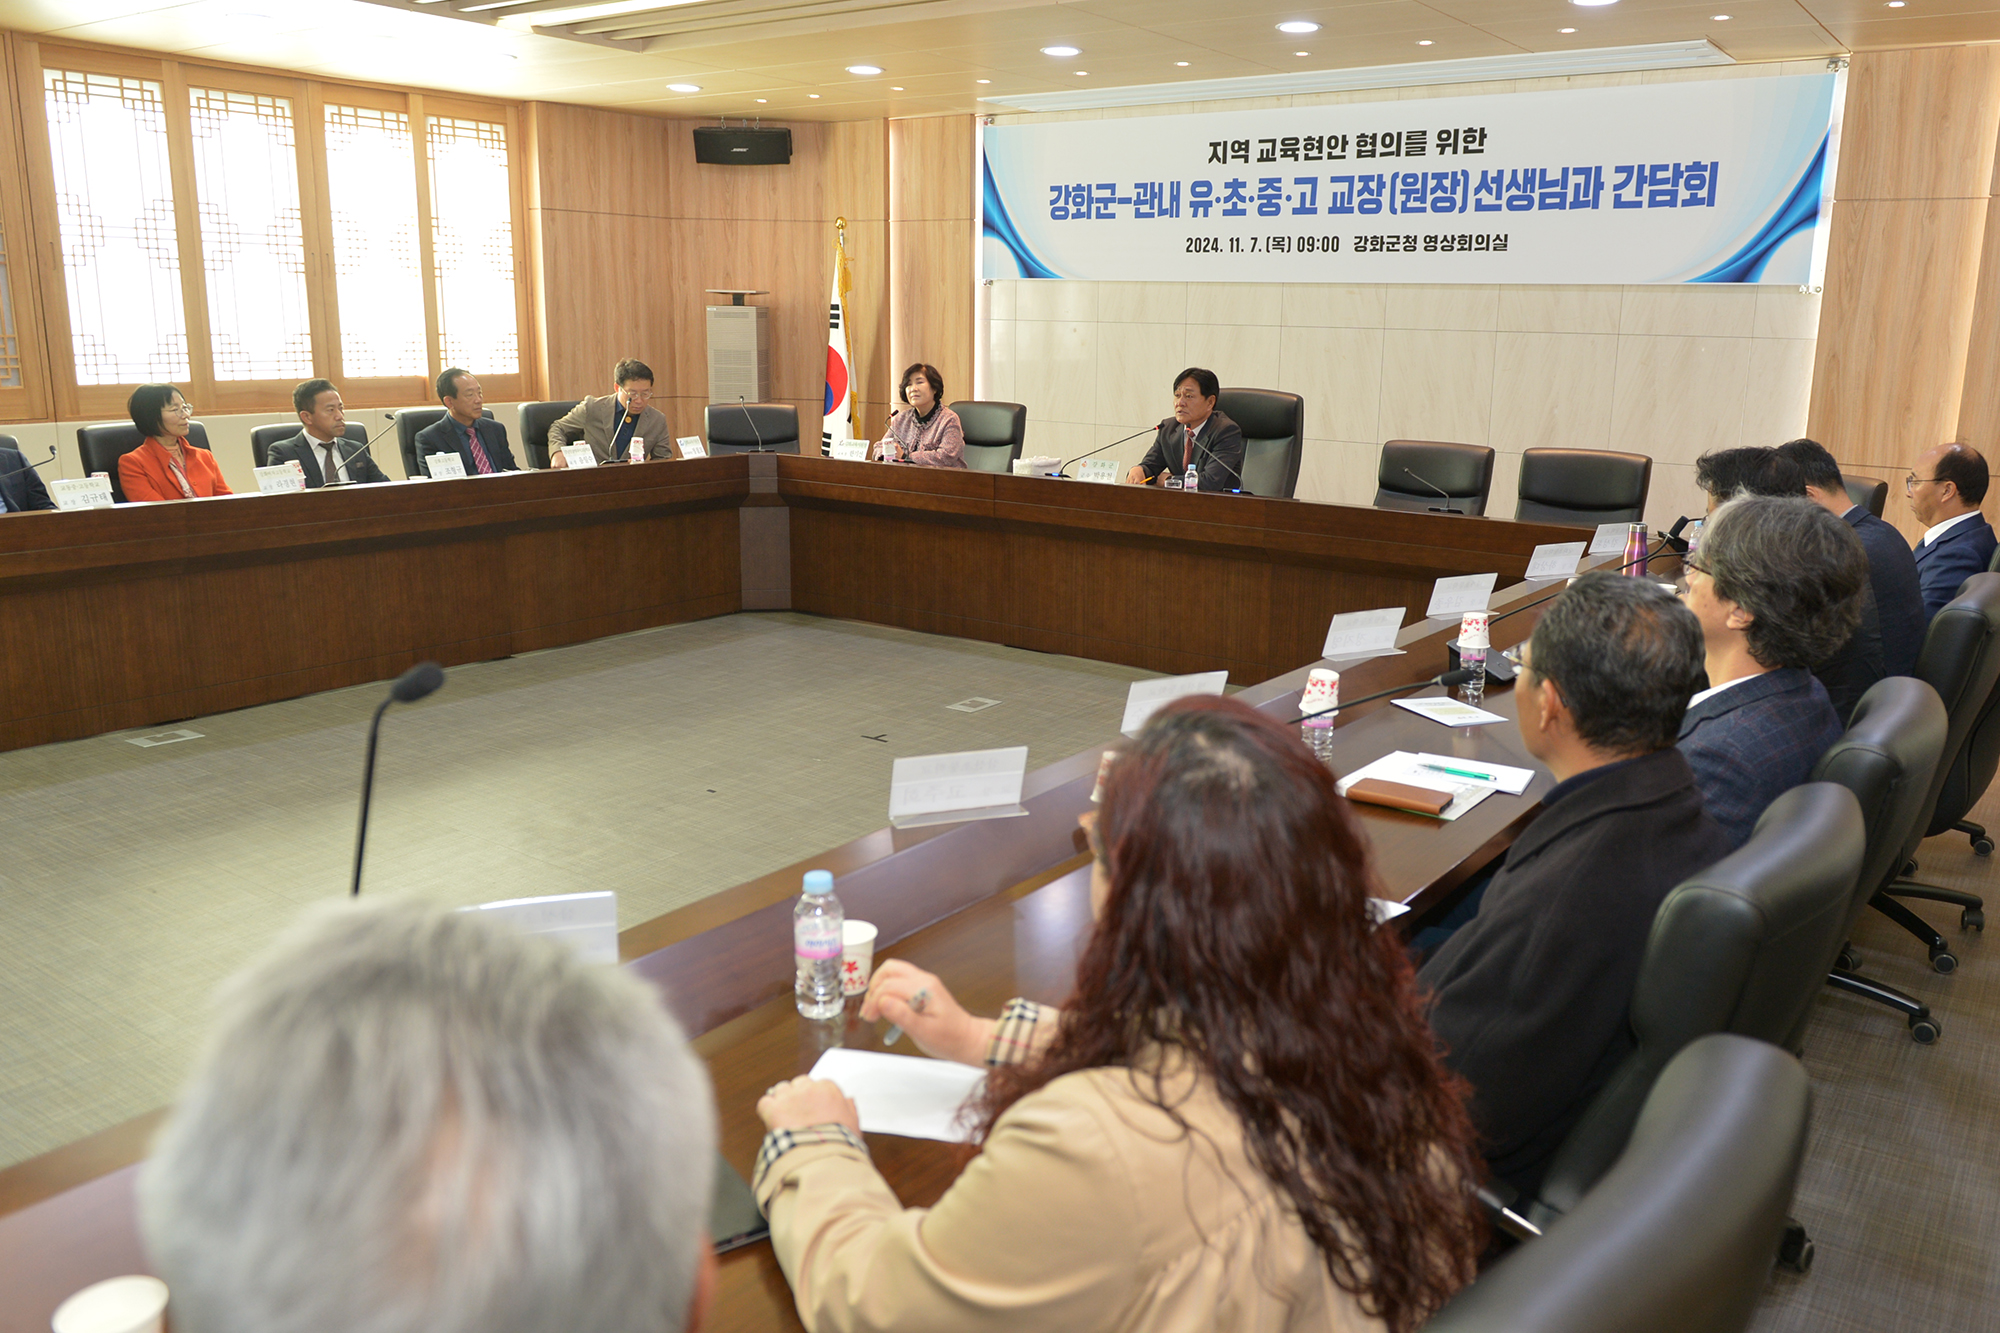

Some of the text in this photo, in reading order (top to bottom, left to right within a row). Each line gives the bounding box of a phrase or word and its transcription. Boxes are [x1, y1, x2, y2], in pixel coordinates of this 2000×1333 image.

[1209, 126, 1488, 165] 지역 교육현안 협의를 위한
[1050, 182, 1181, 220] 강화군-관내
[1613, 161, 1719, 209] 간담회
[1186, 236, 1224, 254] 2024.
[1229, 236, 1245, 253] 11.
[1297, 235, 1340, 253] 09:00
[1354, 234, 1418, 253] 강화군청
[1424, 233, 1509, 252] 영상회의실
